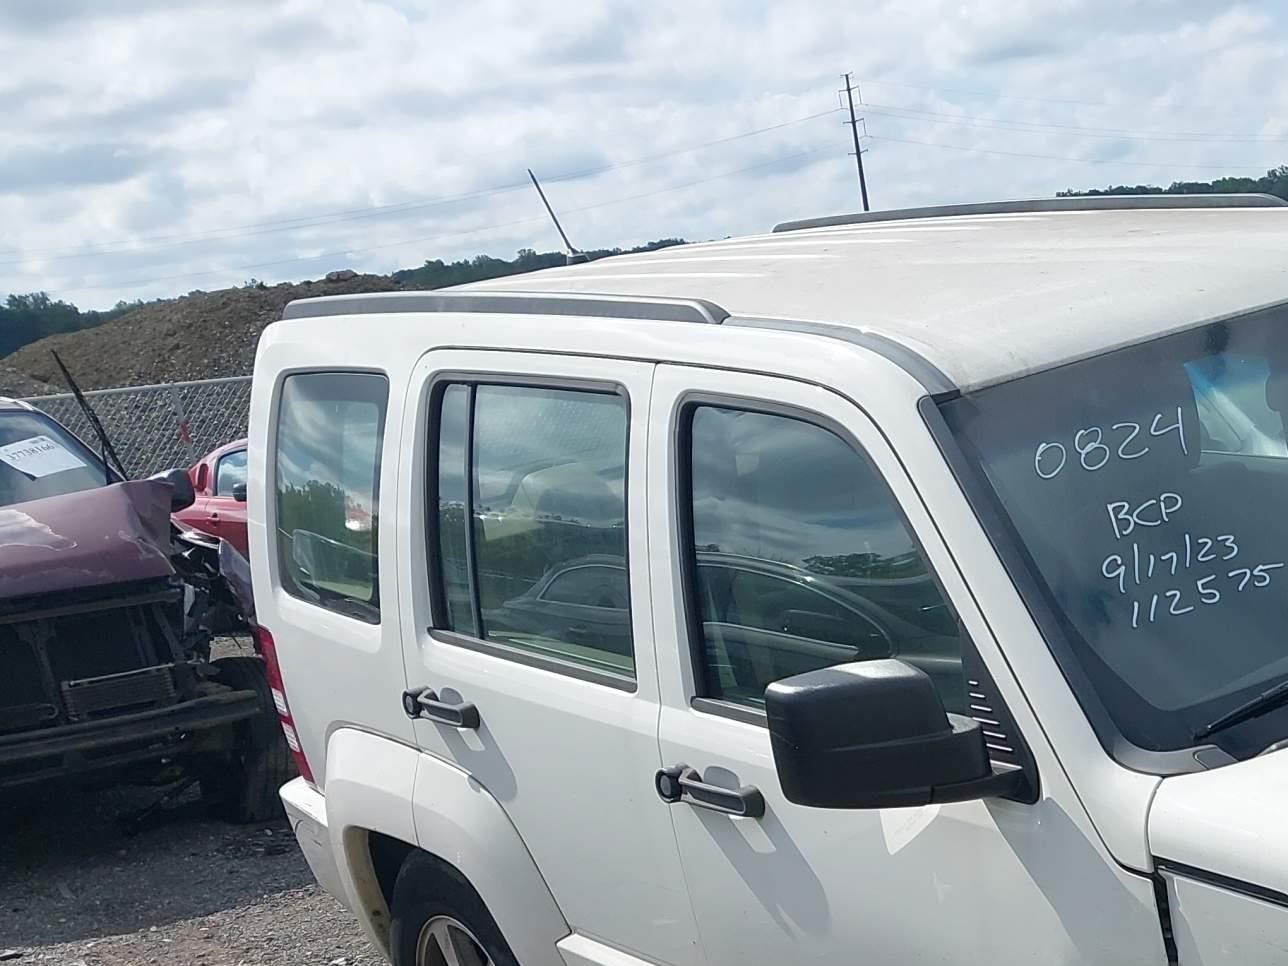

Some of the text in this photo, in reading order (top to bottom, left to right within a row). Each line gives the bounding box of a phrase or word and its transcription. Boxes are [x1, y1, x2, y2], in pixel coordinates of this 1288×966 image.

[1034, 406, 1188, 479] 0824
[1107, 492, 1182, 539] BCP
[1101, 533, 1240, 594] 9/17/23
